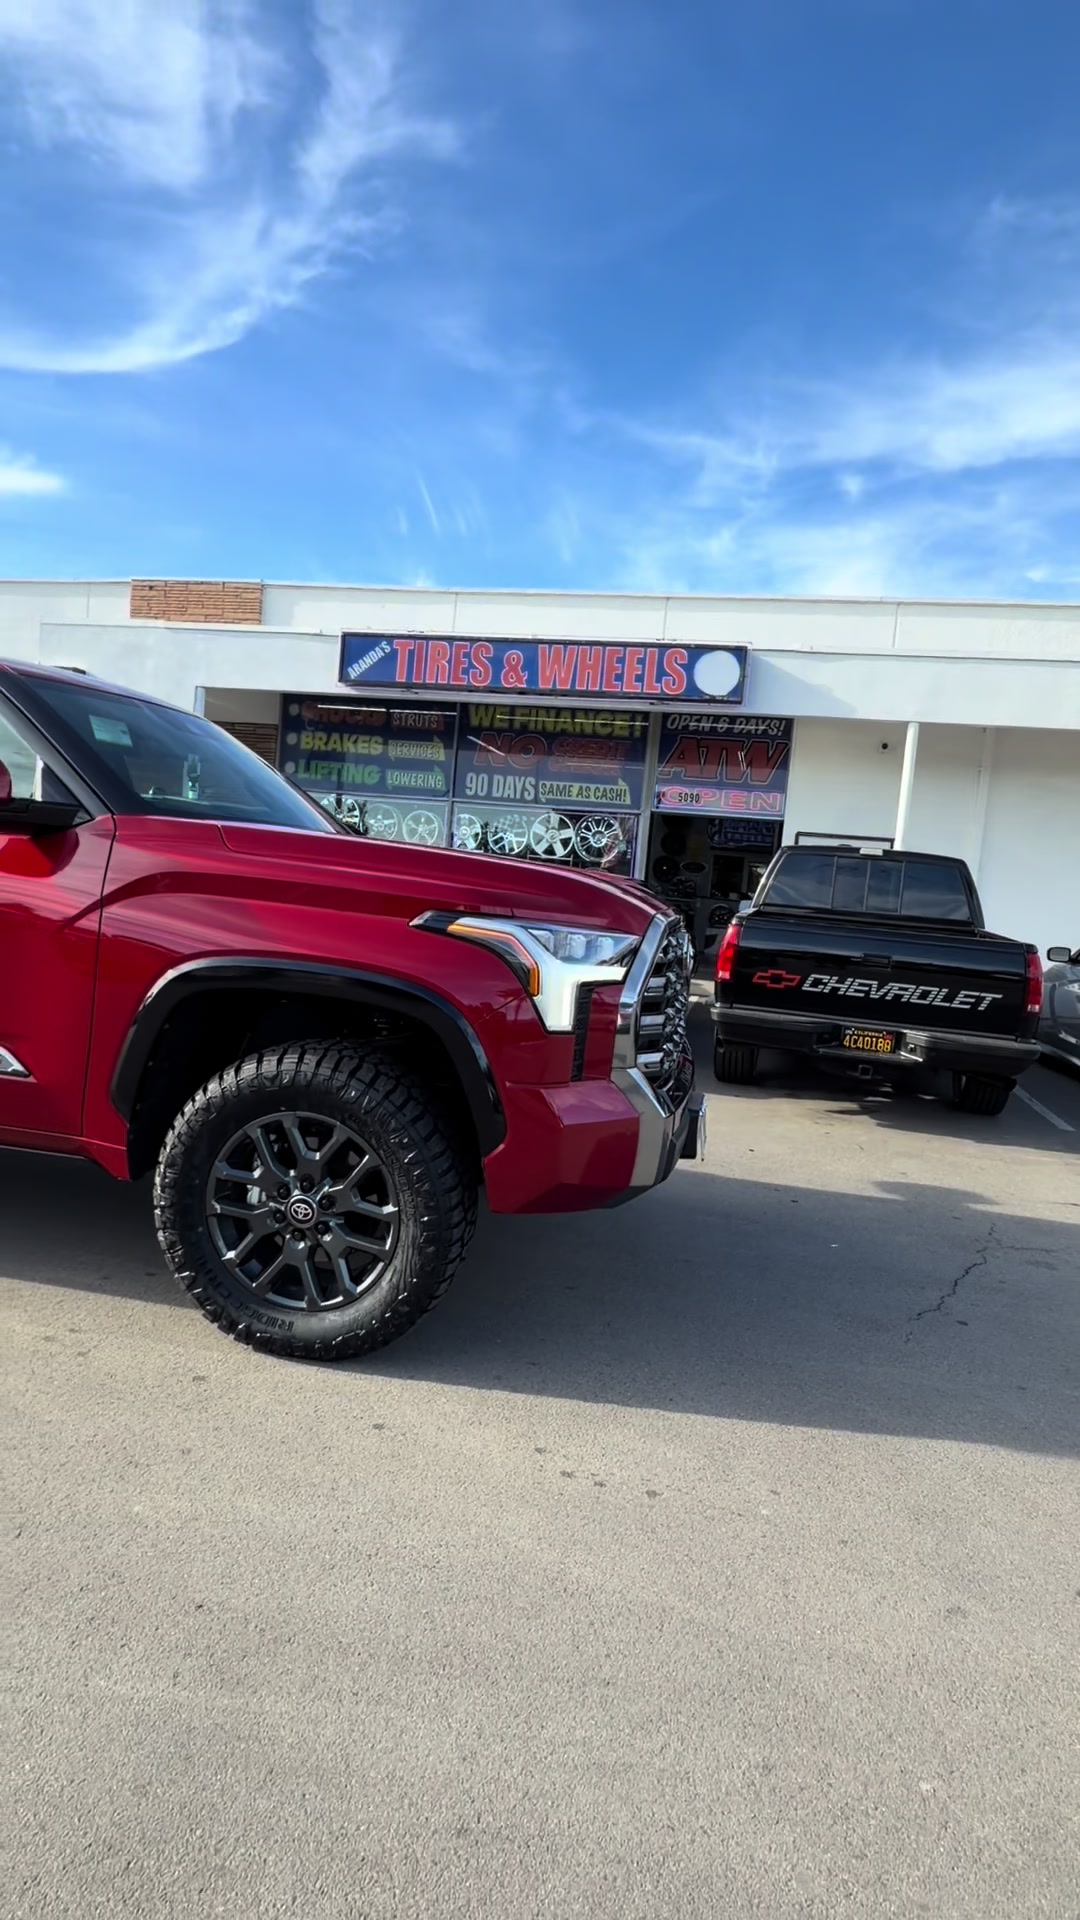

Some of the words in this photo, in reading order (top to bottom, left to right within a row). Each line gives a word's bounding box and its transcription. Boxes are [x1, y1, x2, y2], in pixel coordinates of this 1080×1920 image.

[347, 640, 391, 680] ARANDA'S
[393, 639, 493, 687] TIRES
[501, 649, 527, 688] &
[537, 643, 688, 695] WHEELS
[392, 711, 438, 729] STRUTS
[469, 705, 508, 728] WE
[513, 708, 642, 736] FINANCE!
[666, 713, 714, 731] OPEN
[733, 717, 786, 737] DAYS!
[300, 731, 385, 756] BRAKES
[389, 741, 441, 760] SERVICES
[474, 732, 548, 769] NO
[299, 762, 382, 785] LIFTING
[388, 772, 443, 788] LOWERING
[465, 772, 489, 797] 90
[492, 774, 536, 801] DAYS
[540, 783, 573, 798] SAME
[576, 785, 591, 799] AS
[593, 786, 627, 803] CASH!
[661, 786, 780, 811] OPEN
[677, 792, 700, 804] 5090
[801, 973, 1003, 1011] CHEVROLET
